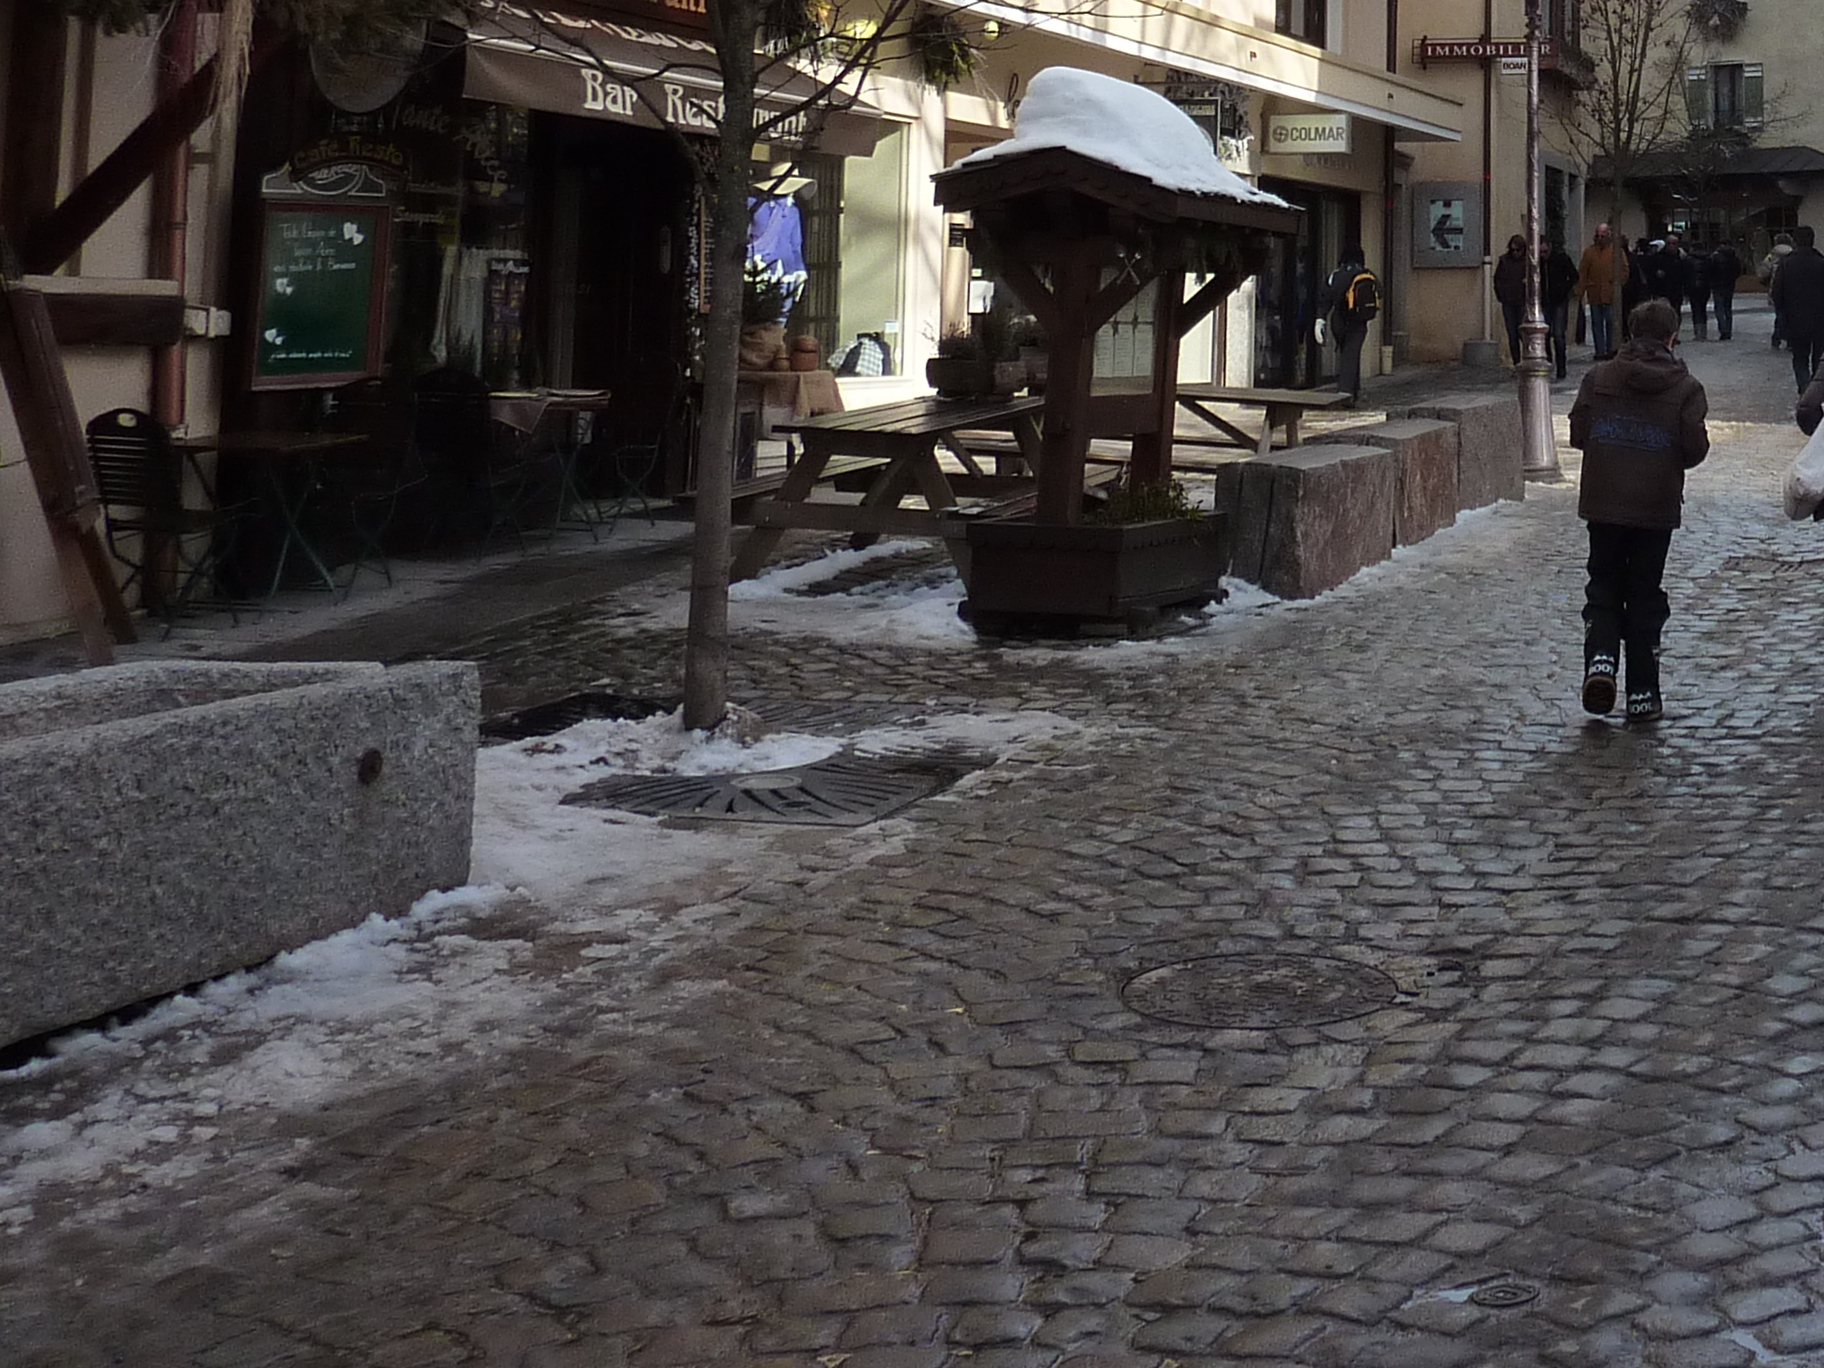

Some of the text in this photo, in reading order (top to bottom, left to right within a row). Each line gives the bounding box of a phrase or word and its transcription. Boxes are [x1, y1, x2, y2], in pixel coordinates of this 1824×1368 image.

[1427, 45, 1551, 56] IMMOBILIR
[581, 68, 807, 141] Bar Restrant
[1290, 126, 1346, 142] COLMAR
